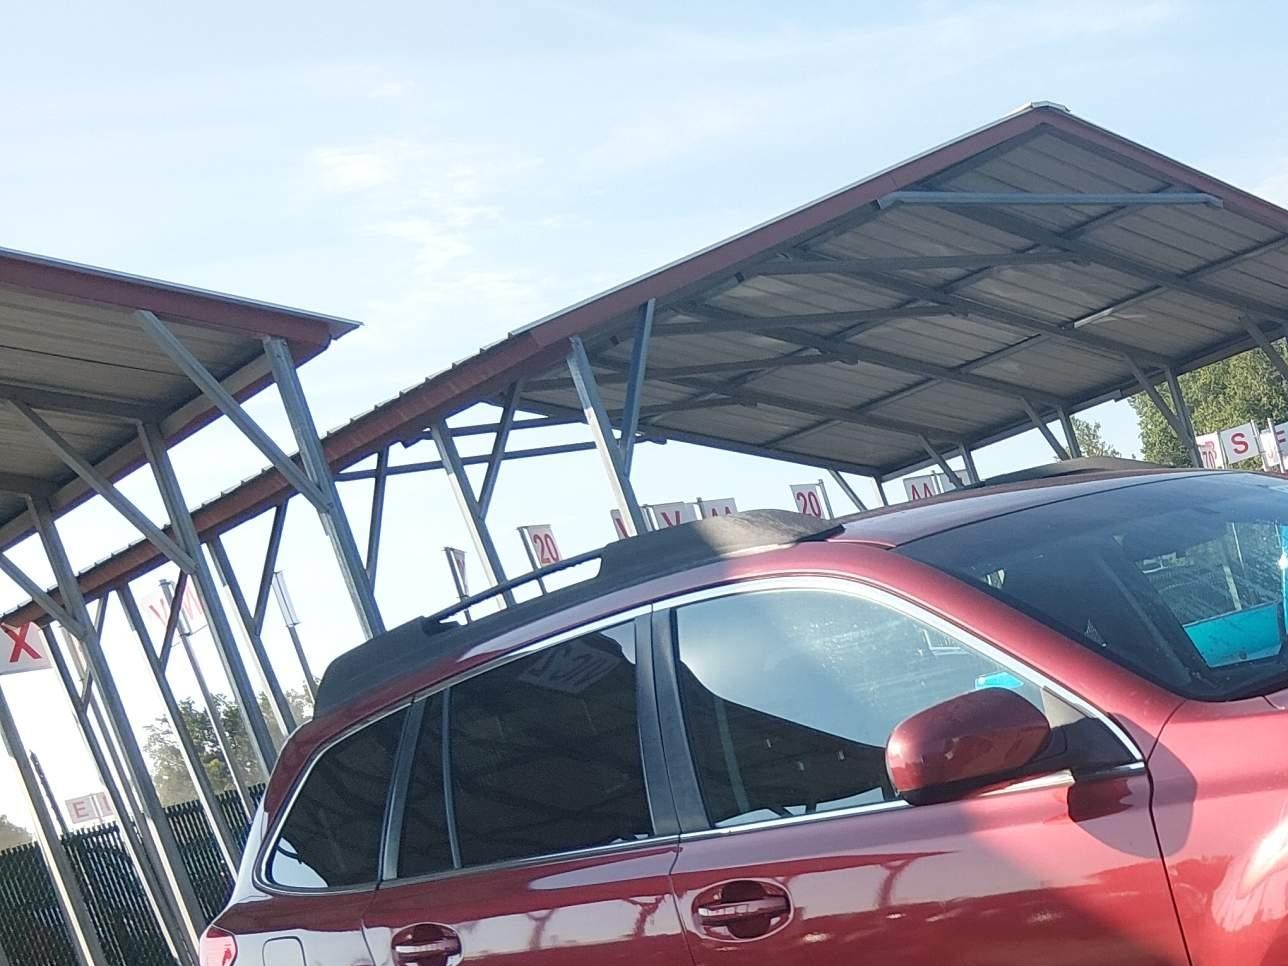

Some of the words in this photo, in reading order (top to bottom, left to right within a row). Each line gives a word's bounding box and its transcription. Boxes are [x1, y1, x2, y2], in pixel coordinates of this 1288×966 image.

[1231, 432, 1249, 454] S
[533, 533, 560, 565] 20
[0, 622, 43, 663] X
[73, 801, 90, 818] E
